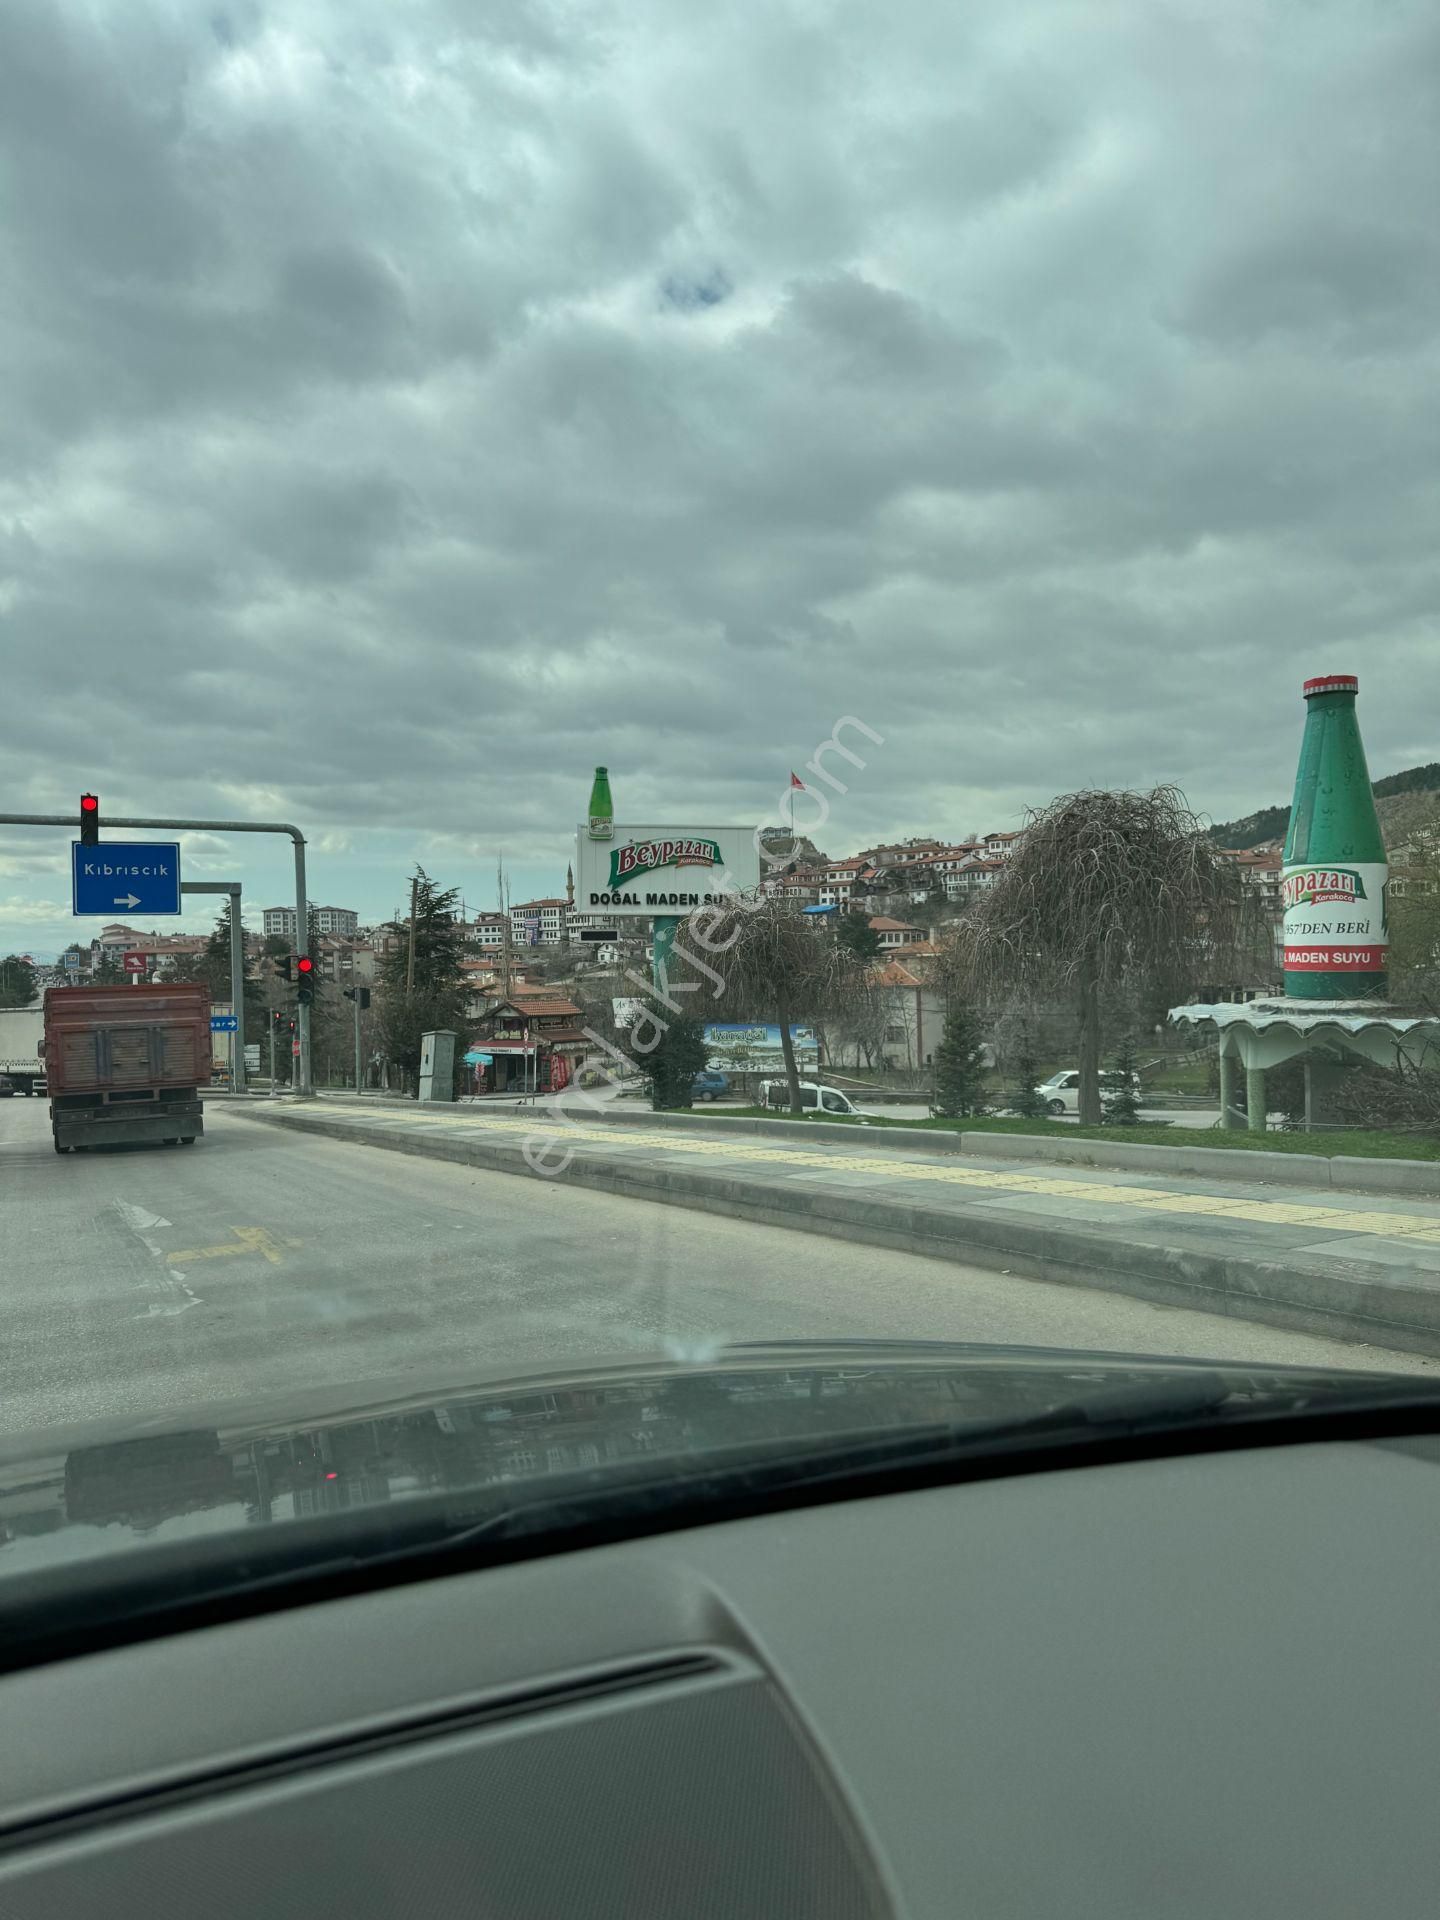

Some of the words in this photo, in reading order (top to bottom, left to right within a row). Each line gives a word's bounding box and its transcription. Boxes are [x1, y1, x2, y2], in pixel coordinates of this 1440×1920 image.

[616, 839, 715, 875] Beypazarı
[84, 863, 169, 876] Kıbrıscık
[590, 889, 641, 906] DOĞAL
[646, 893, 699, 906] MADEN
[1314, 892, 1354, 903] Karakoca
[1335, 918, 1371, 935] BERİ
[1288, 952, 1329, 964] MADEN
[1332, 952, 1371, 964] SUYU
